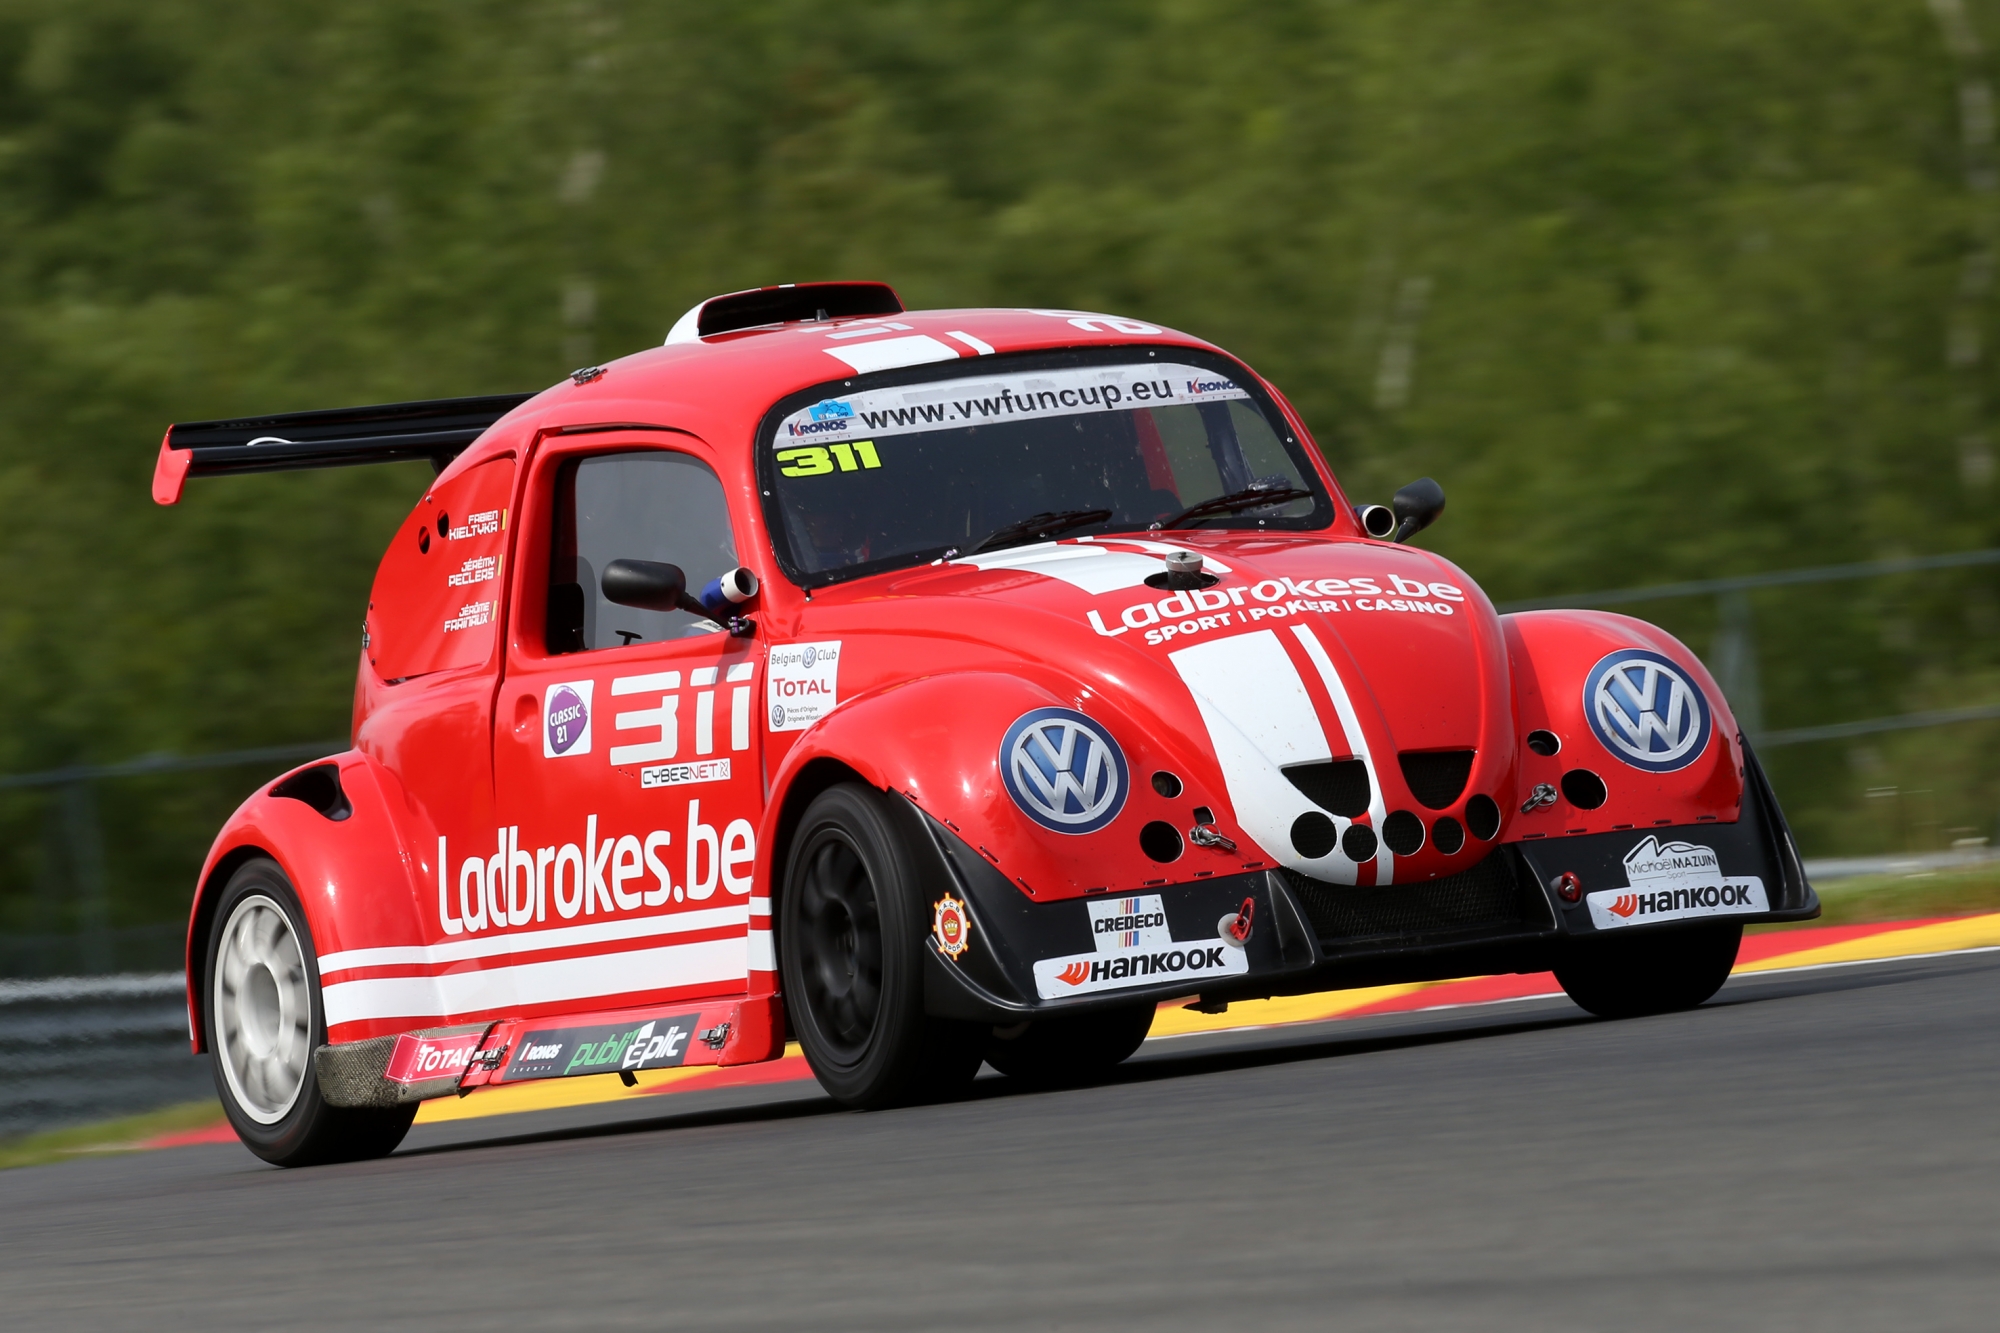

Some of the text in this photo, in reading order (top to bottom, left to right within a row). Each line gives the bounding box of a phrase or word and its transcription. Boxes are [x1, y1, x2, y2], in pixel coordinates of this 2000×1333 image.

[1187, 377, 1238, 394] KRONO
[860, 378, 1173, 429] www.vwfuncup.eu
[788, 419, 847, 436] KRONOS
[776, 441, 882, 478] 311
[468, 510, 499, 525] FABIEN
[449, 521, 498, 541] KIELTYKA
[448, 567, 494, 587] PECLERS
[1086, 574, 1464, 637] Ladbrokes.be
[444, 612, 489, 633] FARINAUX
[1144, 598, 1454, 646] SPORT POKER CASINO
[771, 652, 802, 668] Belgian
[817, 647, 837, 662] Club
[772, 677, 832, 697] TOTAL
[549, 703, 582, 728] CLASSIC
[610, 661, 755, 766] 311
[557, 725, 568, 745] 21
[642, 763, 718, 785] CYBERNET
[438, 799, 756, 936] Ladbrokes.be
[1627, 854, 1717, 875] Michaël MAZUIN
[1666, 870, 1687, 881] Sport
[1094, 912, 1165, 935] CREDECO
[943, 939, 963, 952] SPORT
[518, 1037, 562, 1063] KRONOS
